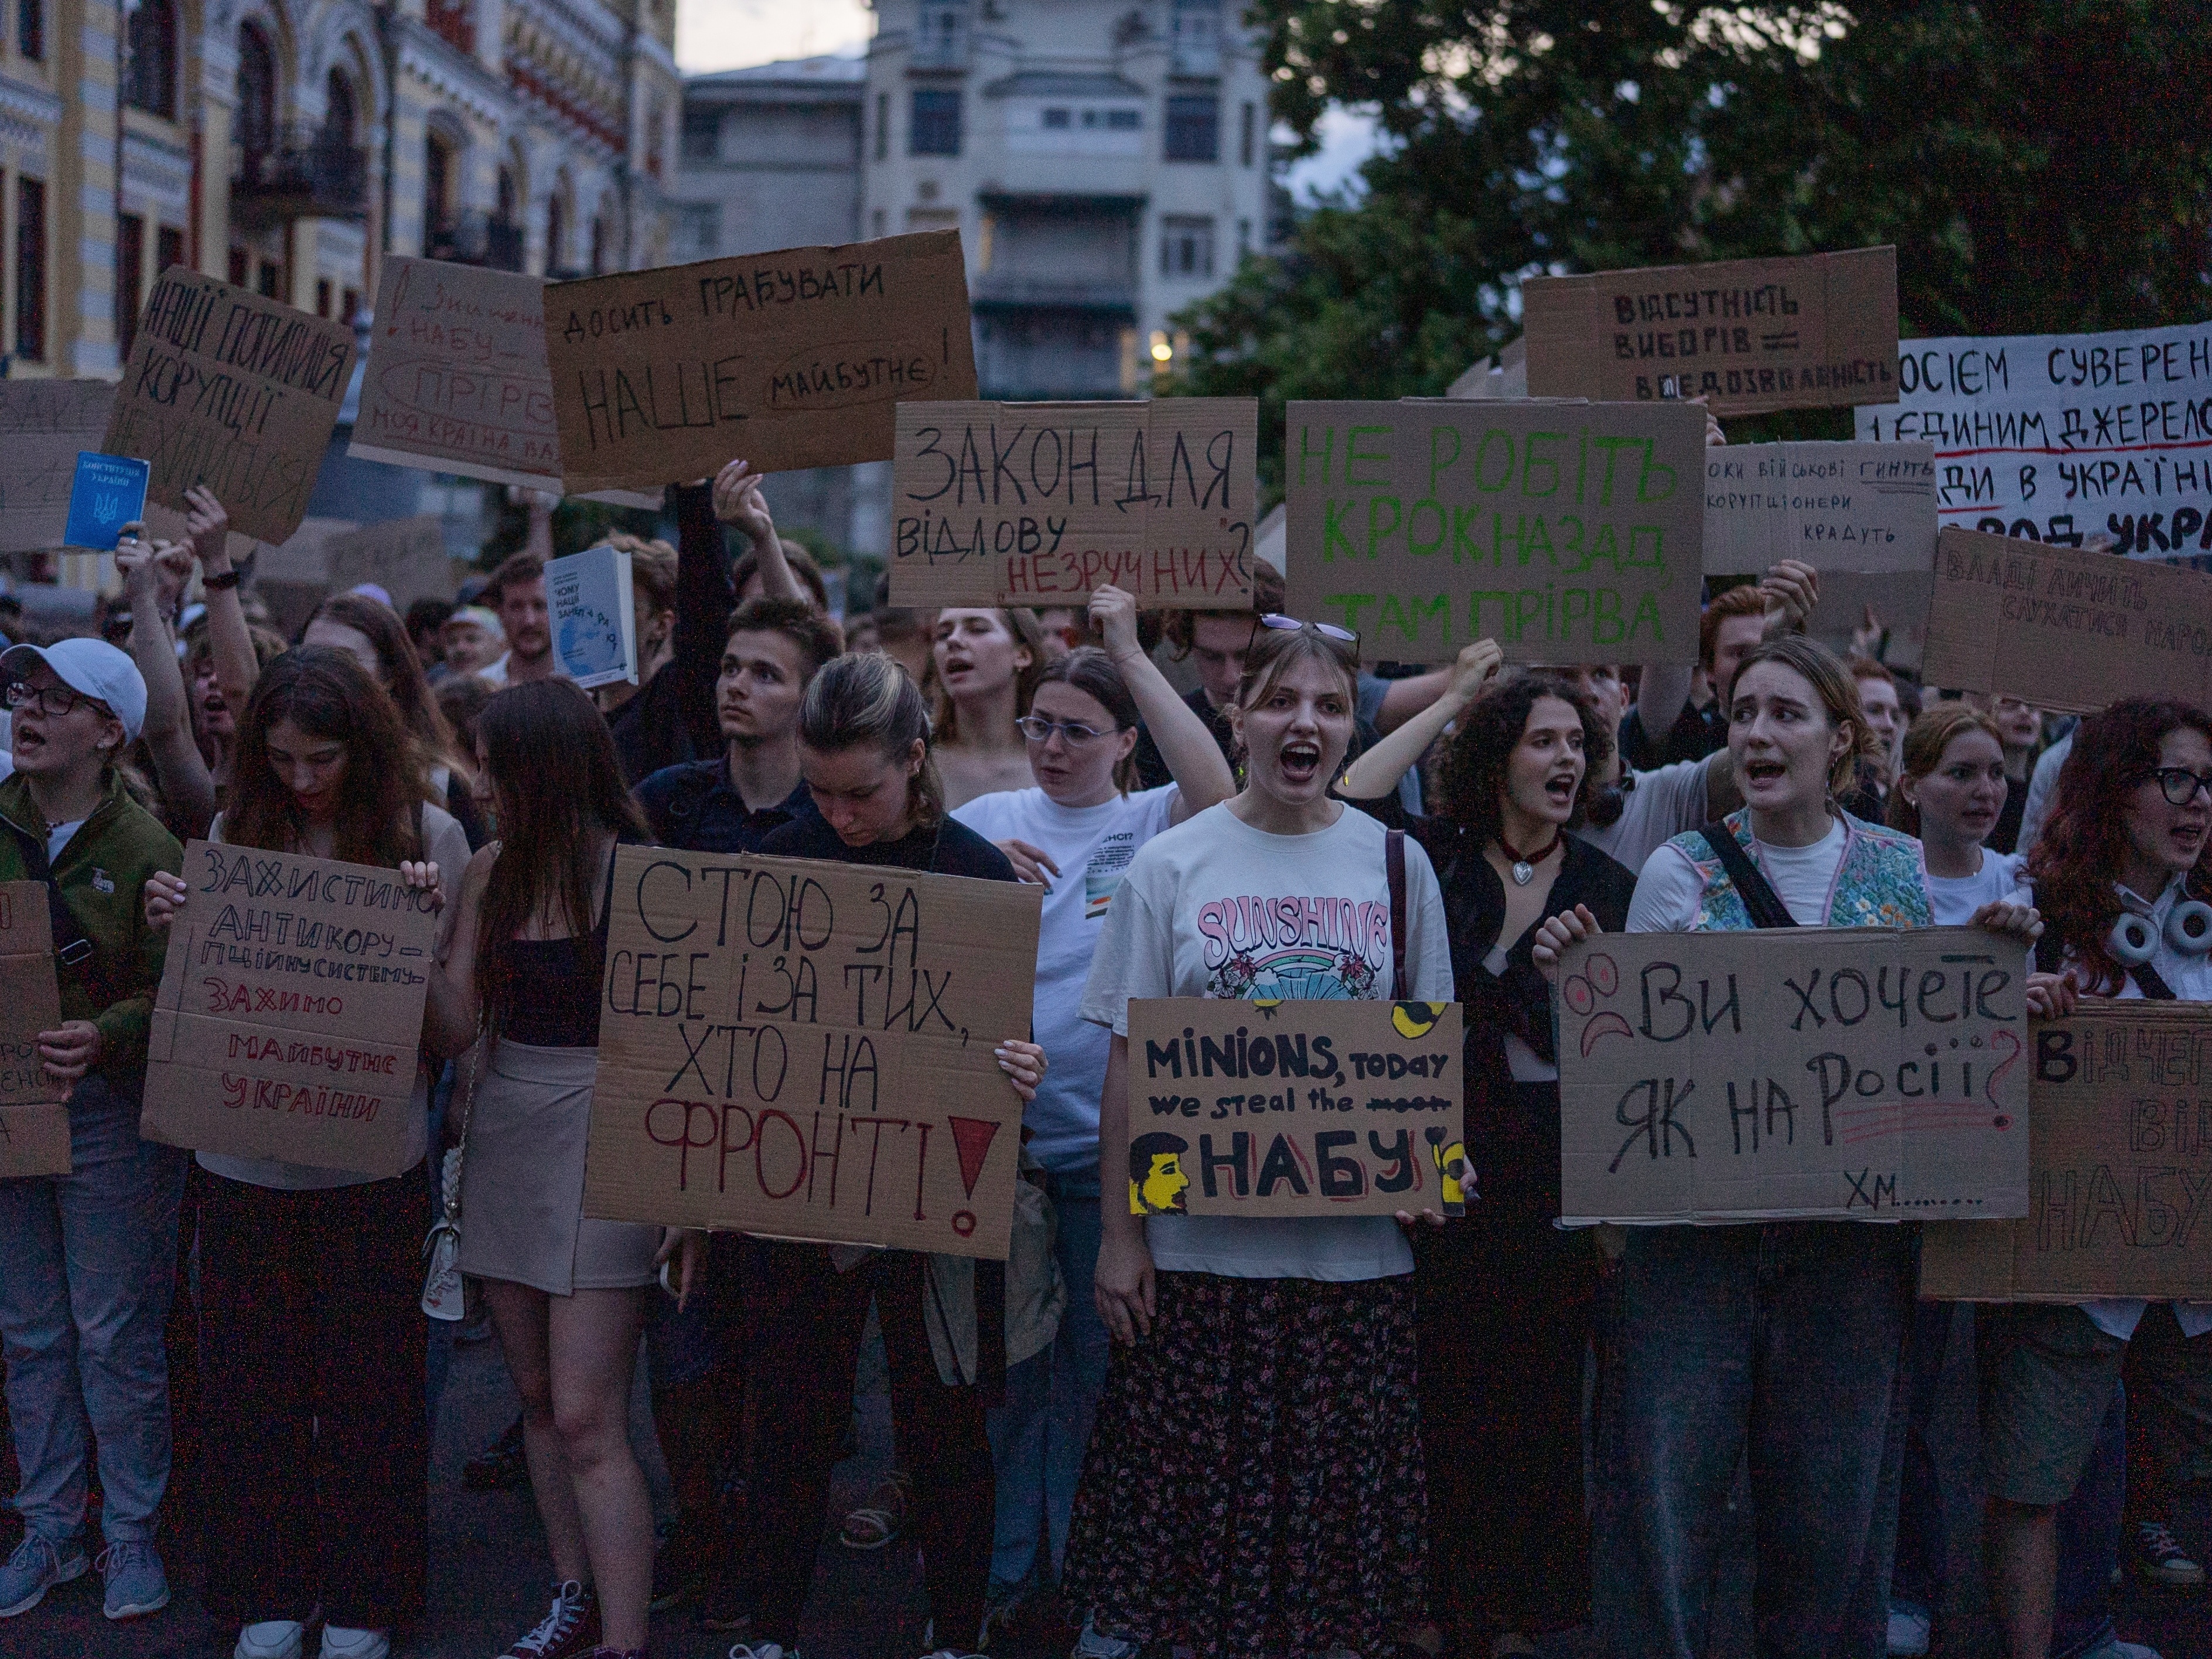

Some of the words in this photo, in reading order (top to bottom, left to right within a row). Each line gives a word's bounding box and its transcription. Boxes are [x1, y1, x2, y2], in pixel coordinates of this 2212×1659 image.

[562, 300, 673, 344] ДОСИТЬ
[698, 264, 885, 318] ГРАБУВАТИ
[1614, 284, 1799, 324] ВІДСУТНІСТЬ
[1614, 326, 1751, 359] ВИБОРІВ
[578, 354, 749, 450] НАШЕ
[1895, 409, 2051, 449] ЄДИНИМ
[906, 422, 1100, 508] ЗАКОН
[1114, 426, 1234, 514] ДЛЯ
[1298, 425, 1394, 487] НЕ
[1936, 465, 1995, 506] ДИ
[2020, 464, 2037, 503] В
[1803, 523, 1896, 545] КРАДУТЬ
[1323, 592, 1453, 644] ТАМ
[2046, 567, 2148, 612] ЛИЧИТЬ
[2002, 594, 2128, 638] СЛУХАТИСЯ
[2144, 619, 2212, 656] НАРО
[636, 859, 834, 953] СТОЮ
[855, 882, 919, 970] ЗА
[1197, 895, 1389, 971] SUNSHINE
[608, 950, 711, 1020] СЕБЕ
[756, 955, 820, 1024] ЗА
[221, 1072, 381, 1123] УКРАЇНИ
[663, 1023, 788, 1102] ХТО
[820, 1032, 878, 1112] НА
[1308, 1087, 1353, 1113] the
[1609, 1078, 1698, 1174] ЯК
[1728, 1077, 1800, 1156] НА
[1199, 1127, 1425, 1202] НАБУ
[2037, 1163, 2212, 1252] НАБУ
